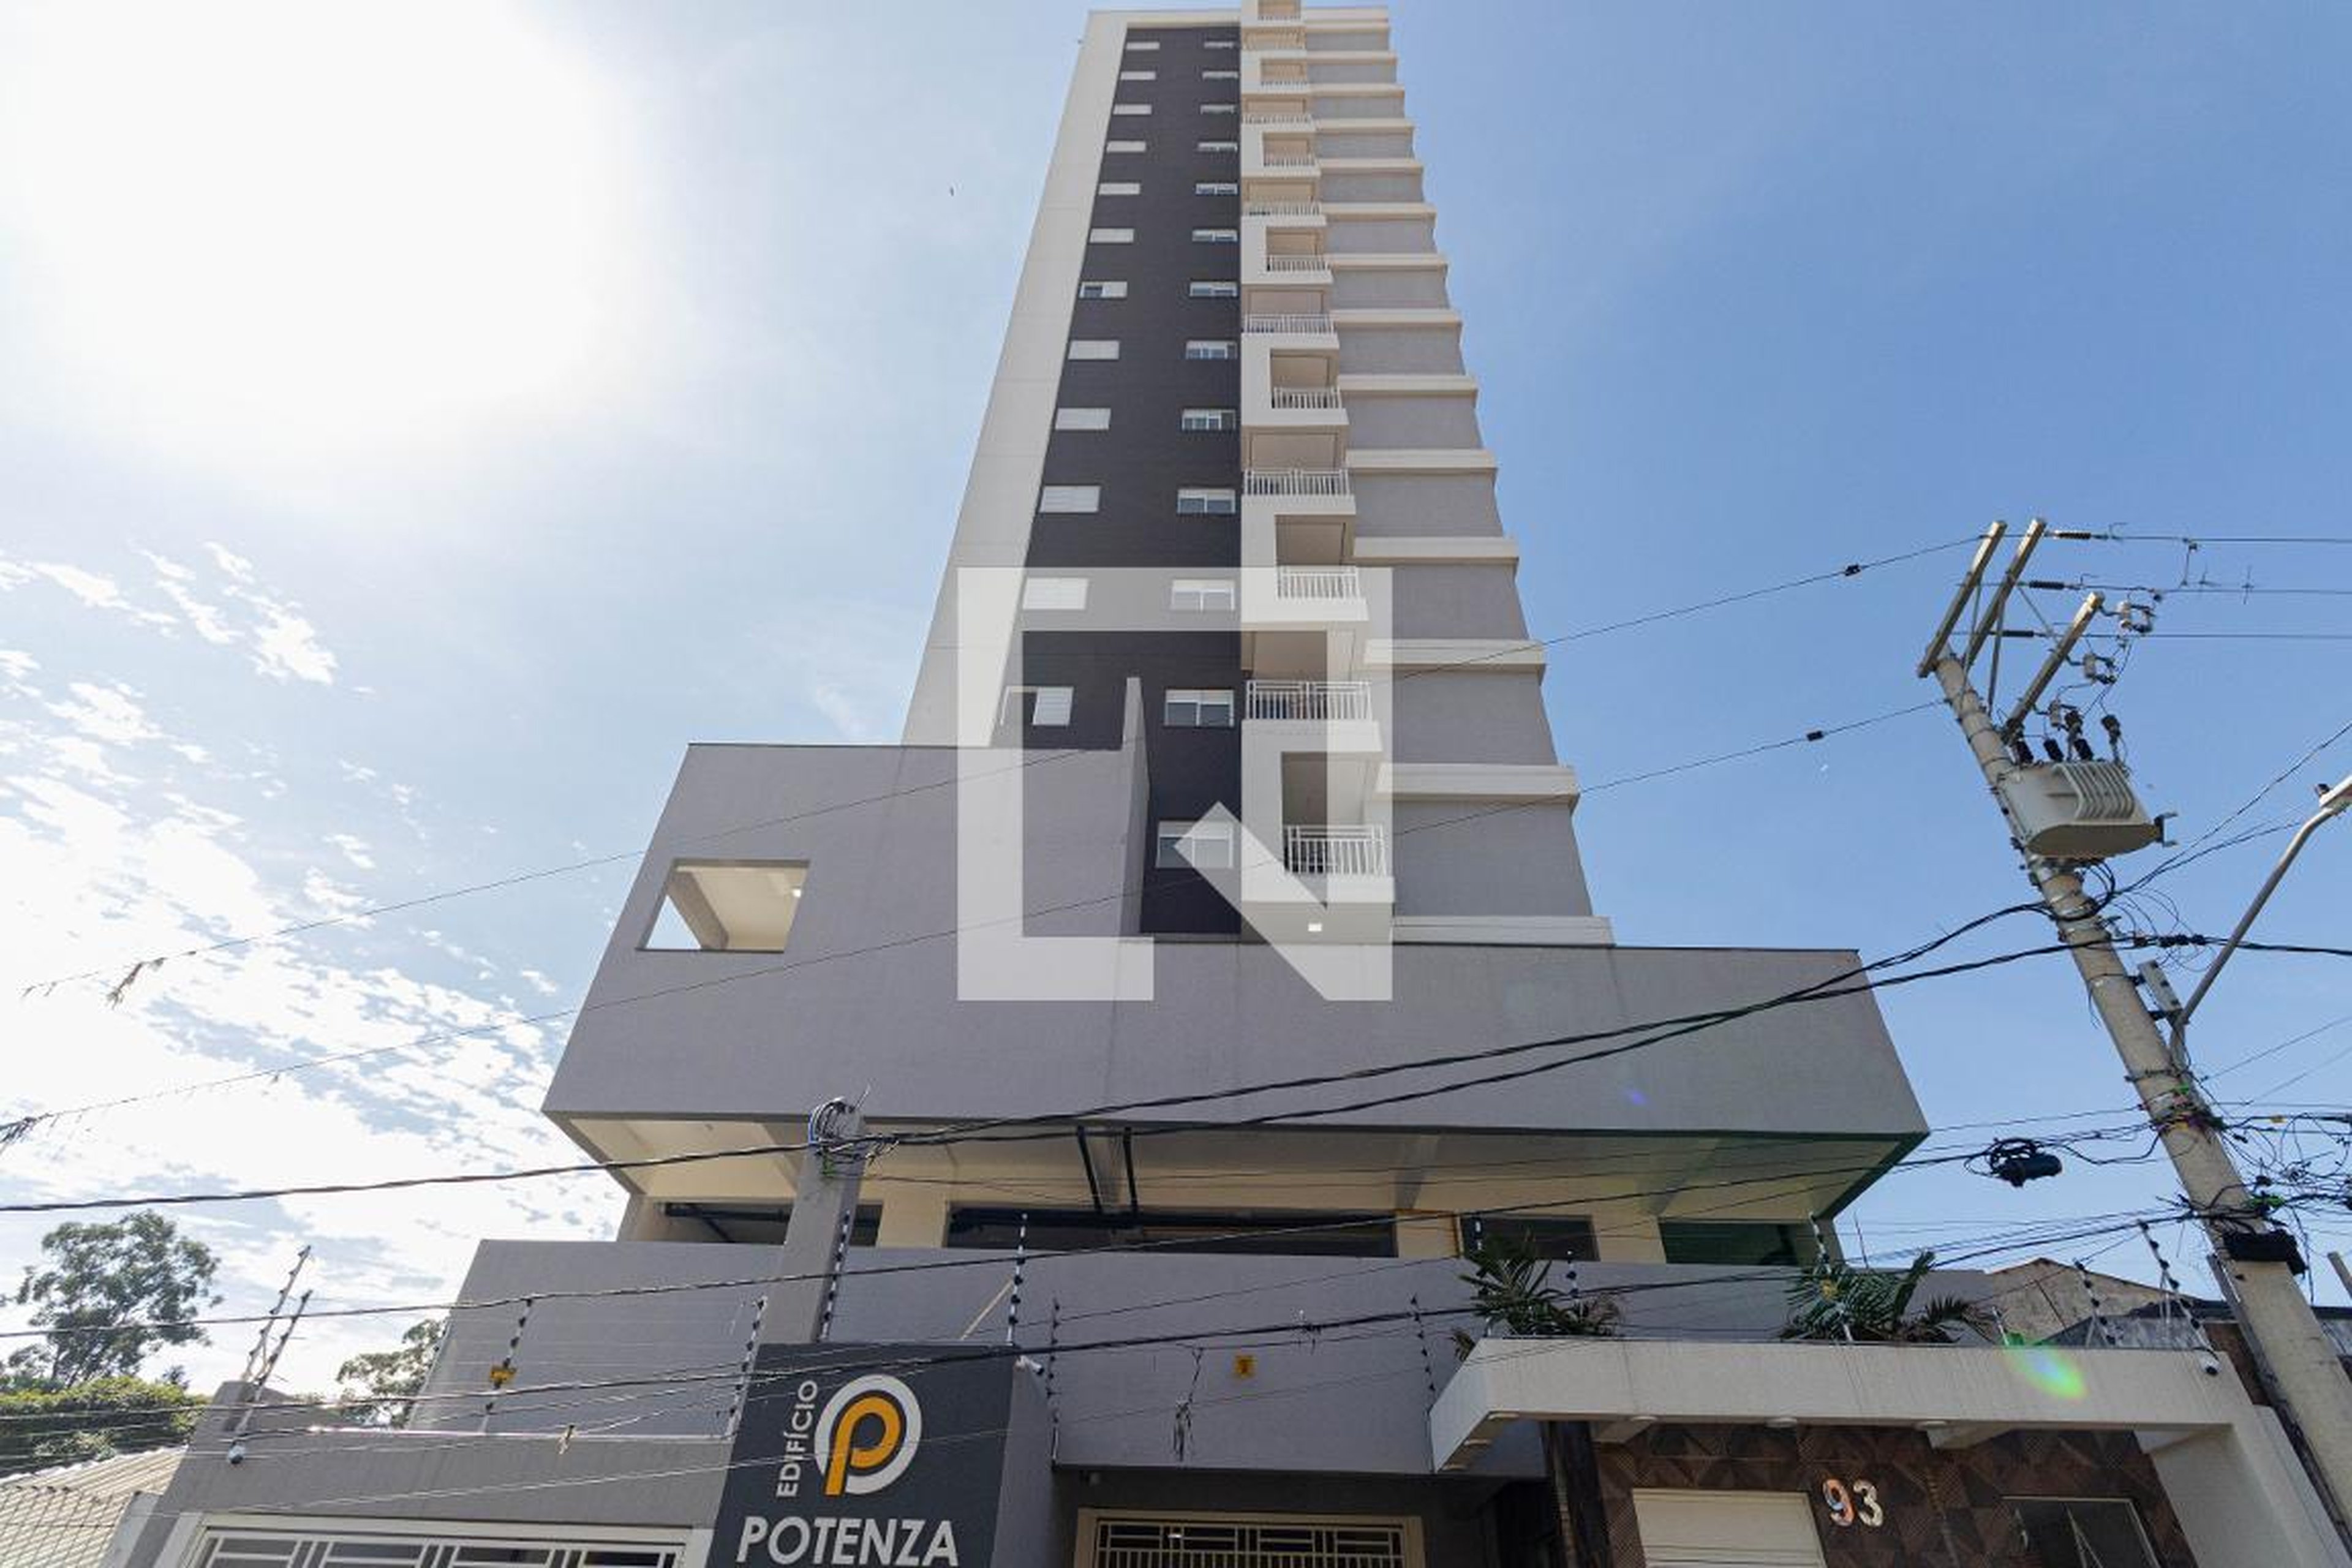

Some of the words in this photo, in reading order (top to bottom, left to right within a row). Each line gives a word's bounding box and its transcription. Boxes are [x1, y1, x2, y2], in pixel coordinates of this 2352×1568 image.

[777, 1381, 818, 1498] EDIFÍCIO
[1822, 1479, 1883, 1526] 93
[737, 1516, 959, 1567] POTENZA
